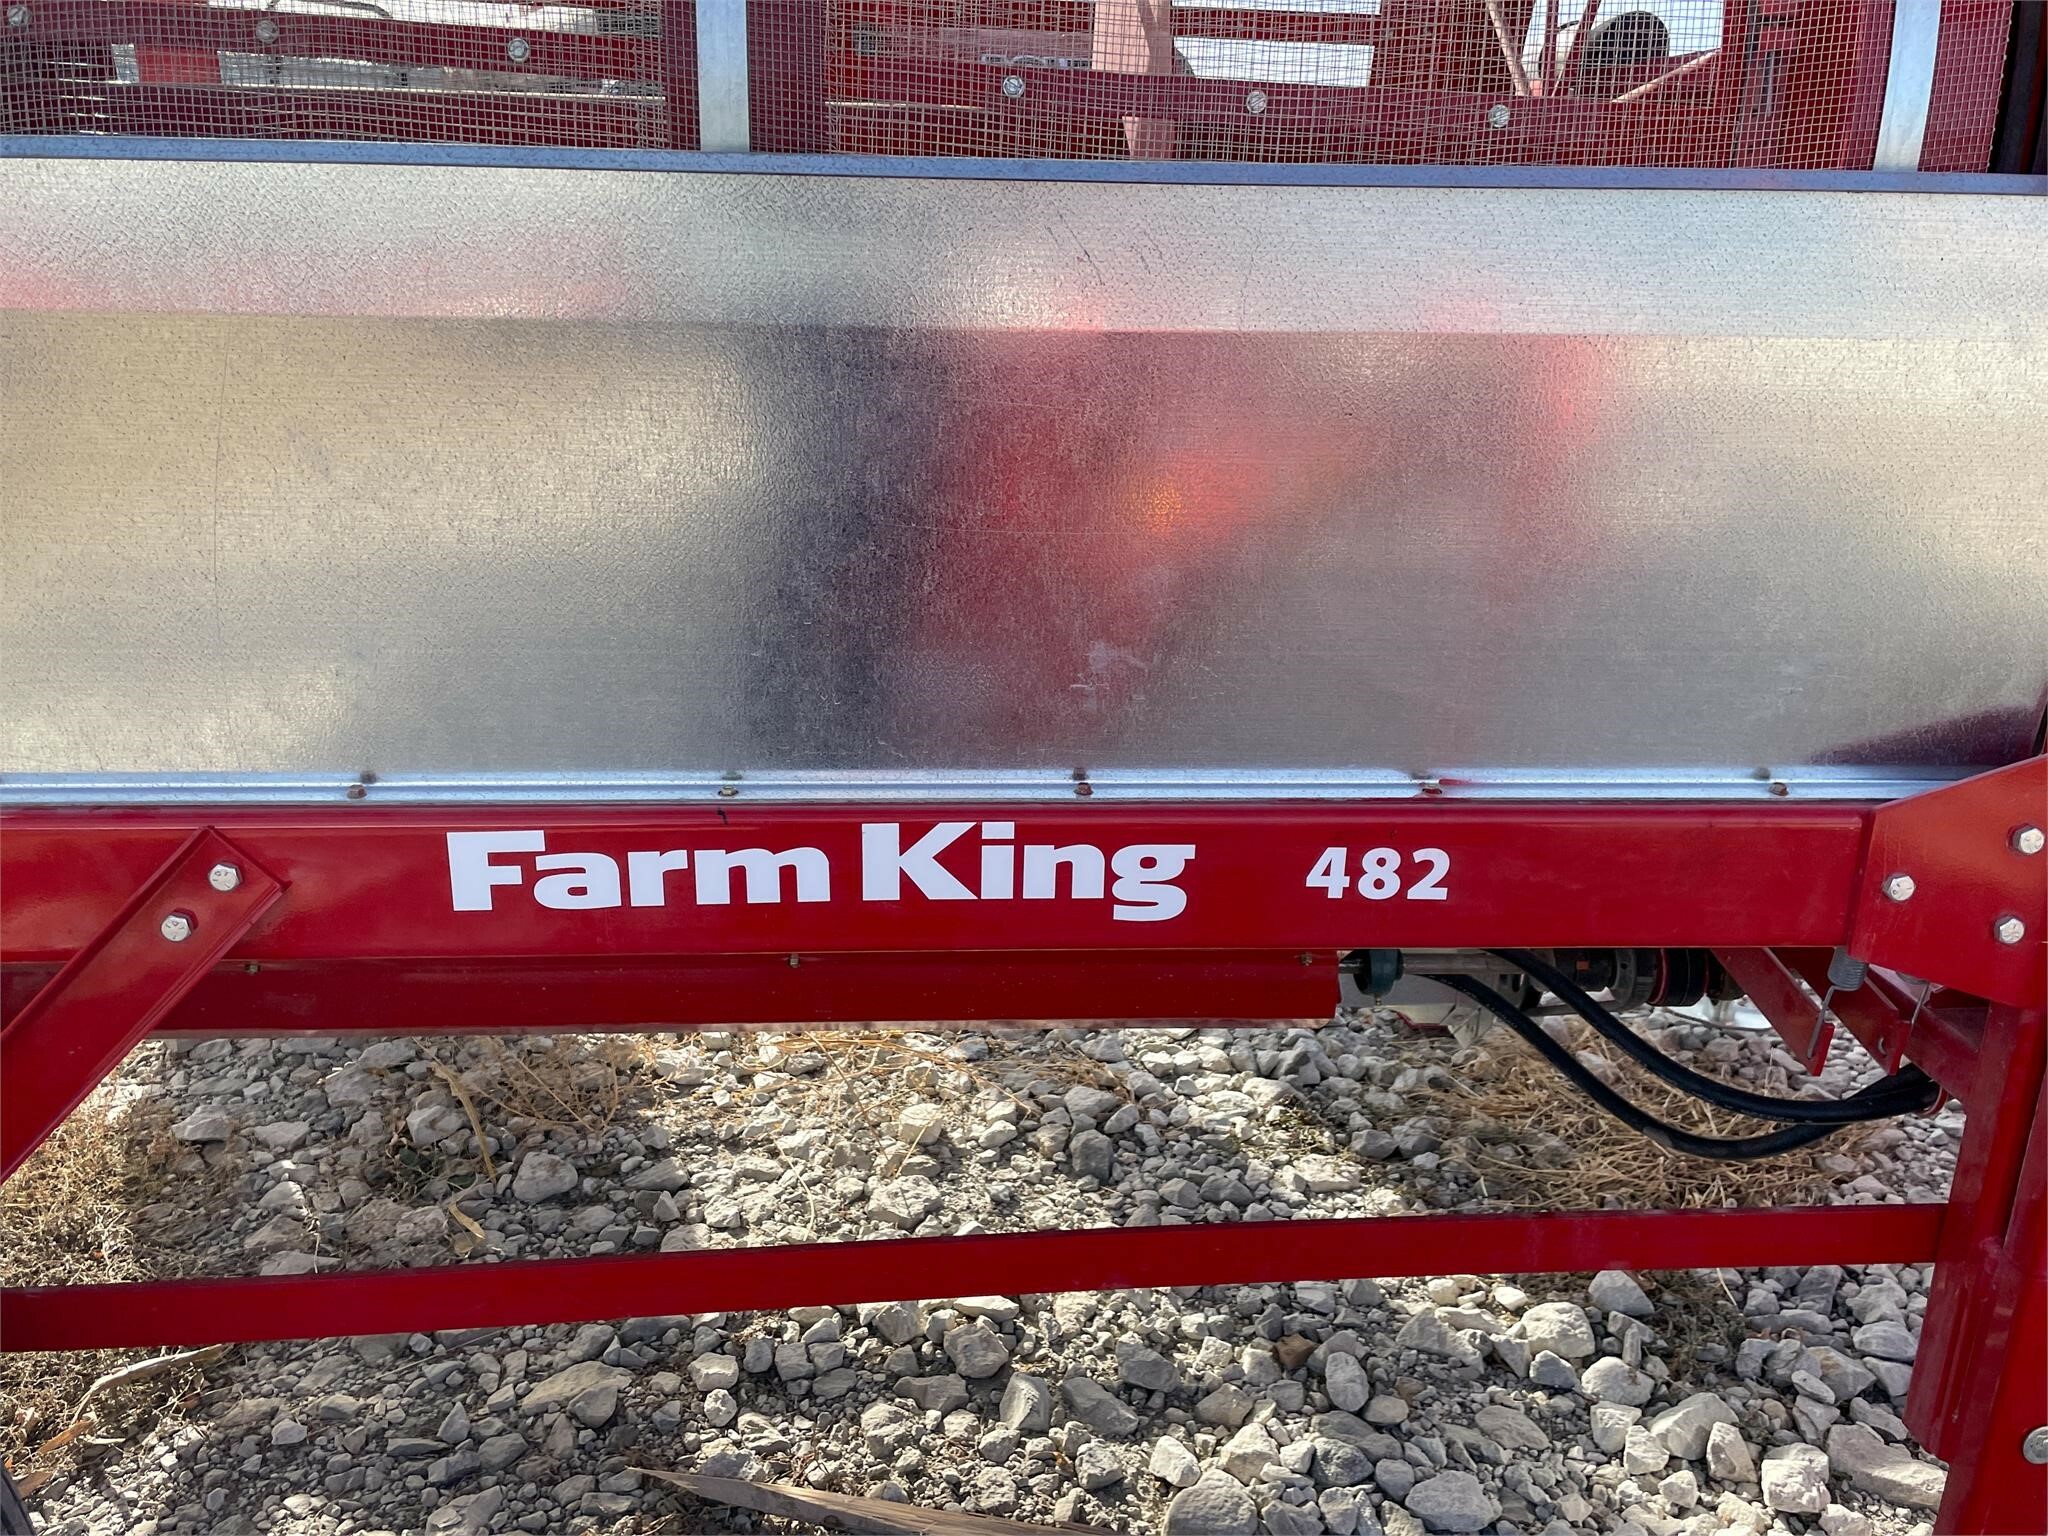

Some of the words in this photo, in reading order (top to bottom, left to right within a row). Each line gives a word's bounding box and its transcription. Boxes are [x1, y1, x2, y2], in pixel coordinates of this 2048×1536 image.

[447, 829, 831, 912] Farm
[861, 821, 1196, 922] King
[1305, 847, 1450, 900] 482
